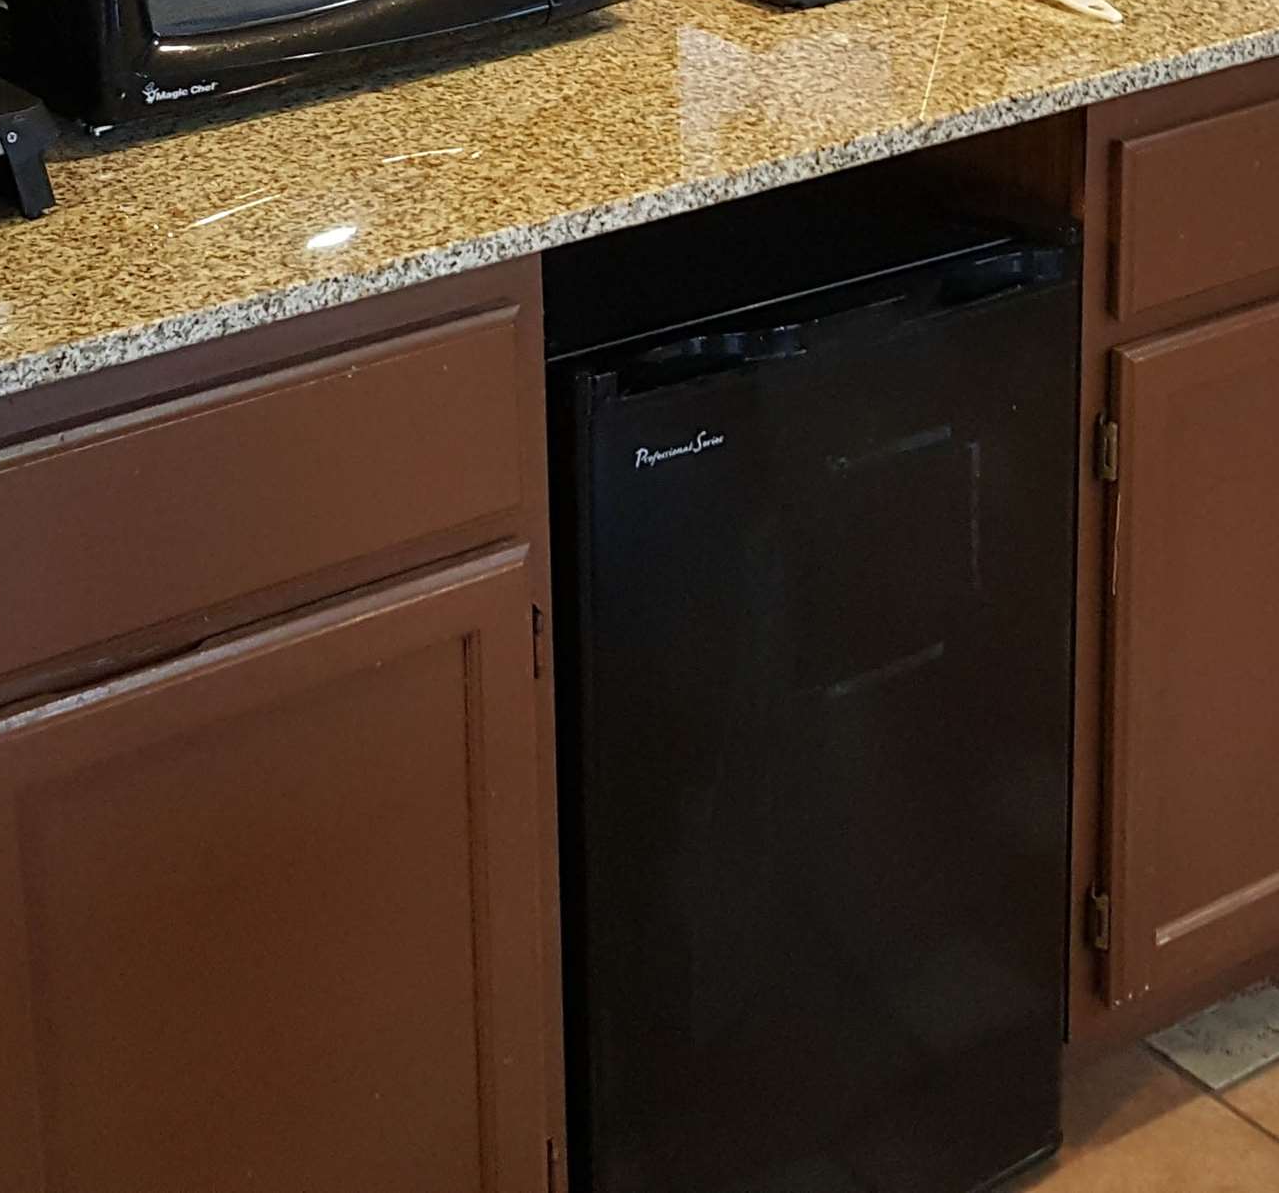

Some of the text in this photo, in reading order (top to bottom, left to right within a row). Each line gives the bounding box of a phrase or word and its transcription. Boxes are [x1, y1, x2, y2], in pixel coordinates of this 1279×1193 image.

[156, 82, 219, 101] Magic Chef
[635, 430, 725, 468] Professional Series
